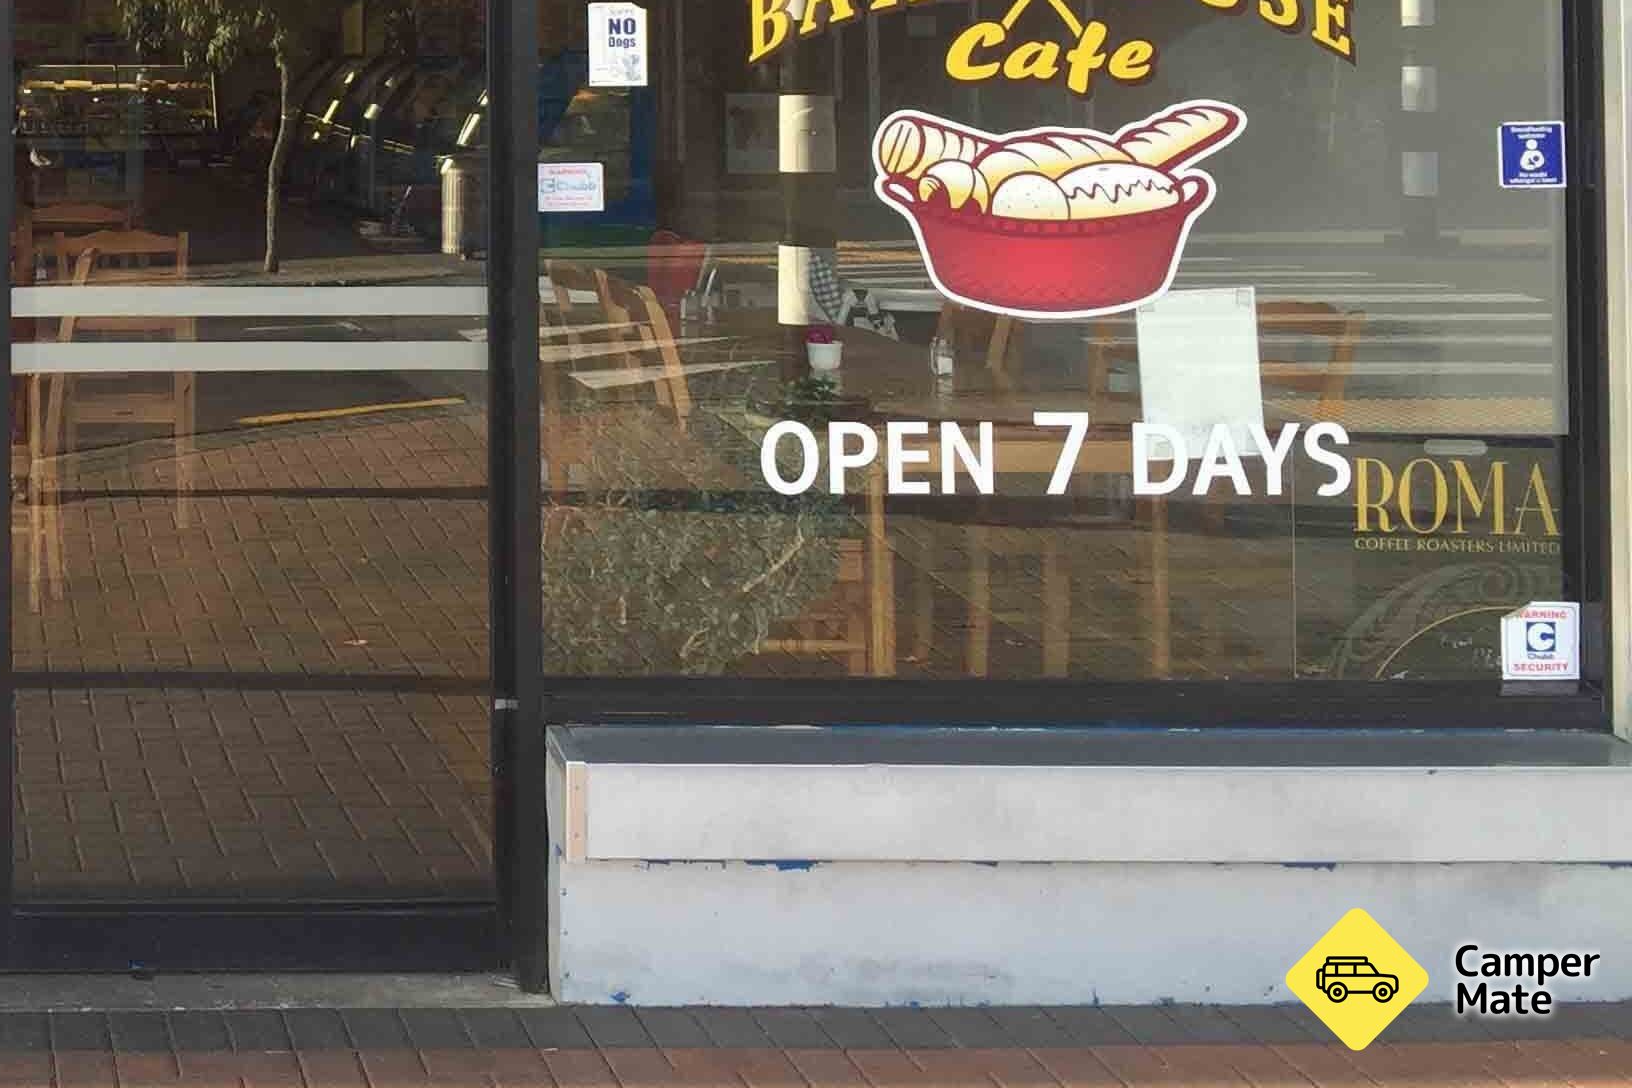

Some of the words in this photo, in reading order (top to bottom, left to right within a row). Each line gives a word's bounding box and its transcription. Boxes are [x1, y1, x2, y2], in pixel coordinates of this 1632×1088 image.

[608, 17, 636, 35] NO
[608, 37, 636, 49] Dogs
[945, 20, 1155, 95] Cafe
[760, 419, 994, 496] OPEN
[1031, 411, 1090, 496] 7
[1131, 420, 1353, 498] DAYS
[1352, 457, 1561, 536] ROMA
[1353, 536, 1412, 552] COFFEE
[1416, 537, 1496, 553] ROASTERS
[1512, 663, 1569, 672] SECURITY
